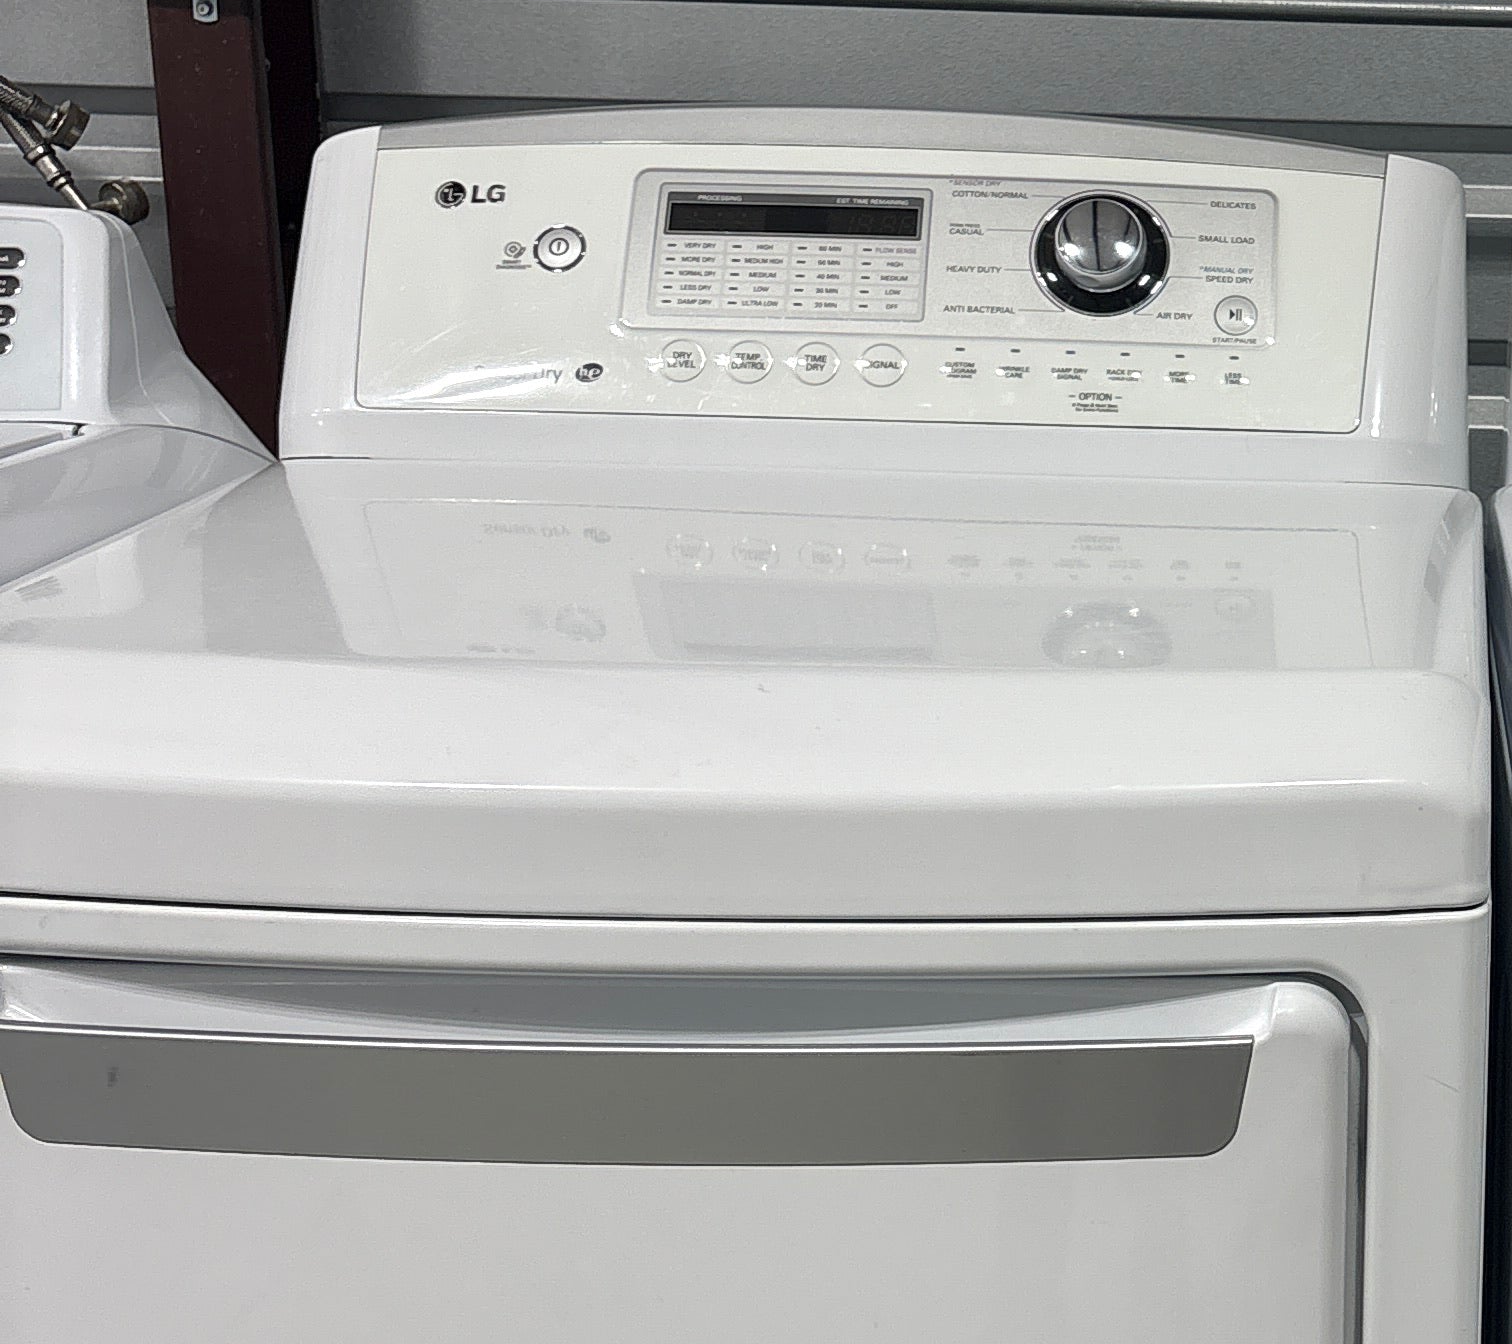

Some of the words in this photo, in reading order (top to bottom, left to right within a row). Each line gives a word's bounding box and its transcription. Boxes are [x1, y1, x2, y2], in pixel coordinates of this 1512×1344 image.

[471, 184, 506, 203] LG
[1210, 200, 1257, 210] DELICATES
[948, 228, 985, 236] CASUAL
[1198, 234, 1229, 244] SMALL
[1230, 236, 1256, 245] LOAD
[946, 265, 976, 273] HEAVY
[977, 266, 1002, 274] DUTY
[1237, 267, 1254, 275] DRY
[1205, 275, 1234, 284] SPEED
[1235, 276, 1254, 285] DRY
[943, 305, 965, 313] ANTI
[967, 305, 1016, 314] BACTERIAL
[1173, 312, 1193, 320] DRY
[672, 351, 693, 360] DRY
[804, 354, 828, 363] TIME
[805, 362, 826, 372] DRY
[1079, 392, 1112, 402] OPTION
